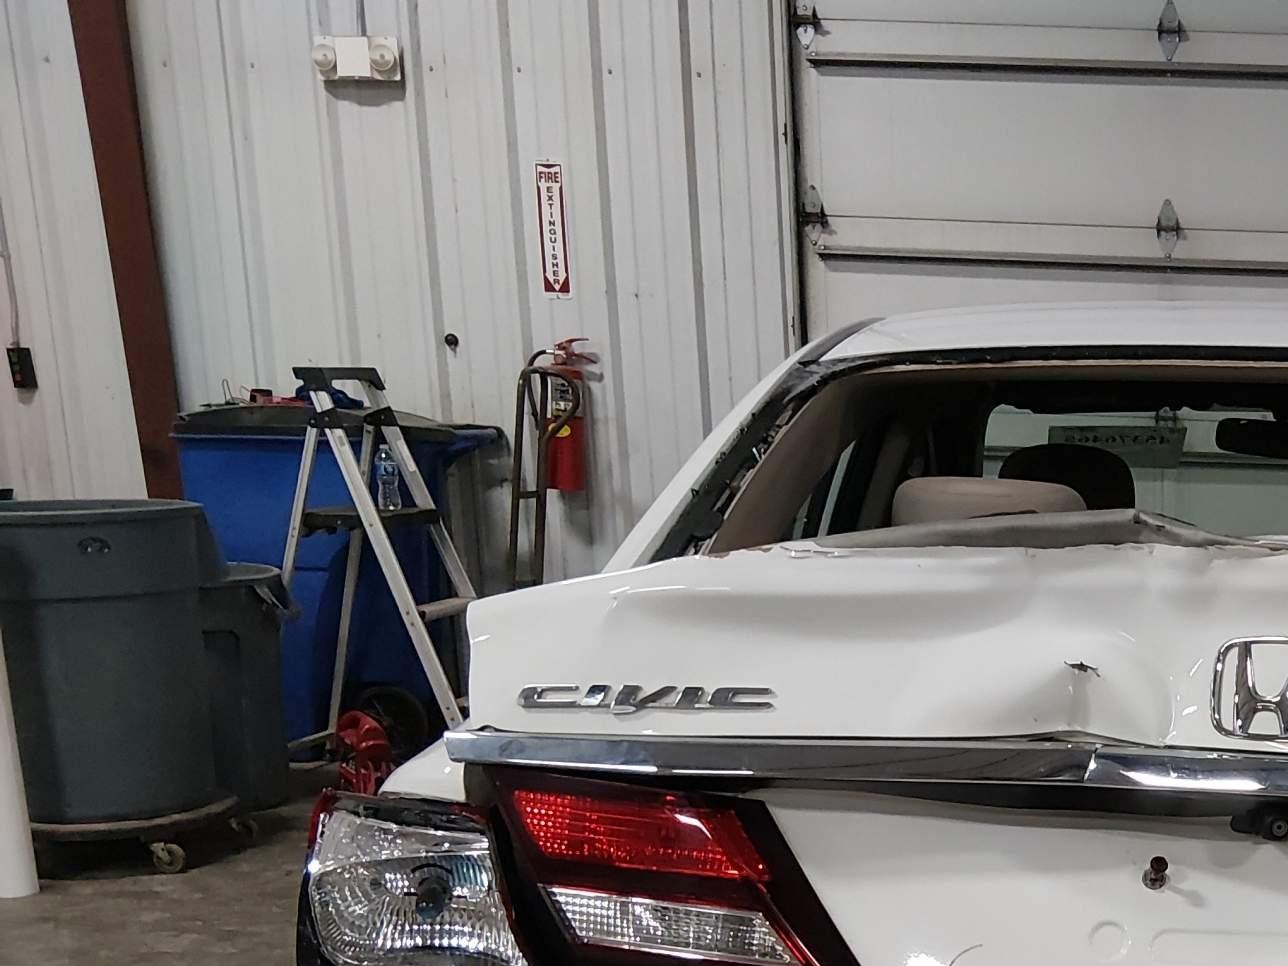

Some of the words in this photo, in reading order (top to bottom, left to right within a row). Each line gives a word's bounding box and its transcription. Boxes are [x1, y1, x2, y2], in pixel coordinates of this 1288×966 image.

[538, 171, 560, 184] FIRE
[546, 186, 560, 286] EXTINGUISHER
[518, 684, 776, 714] CIVIC
